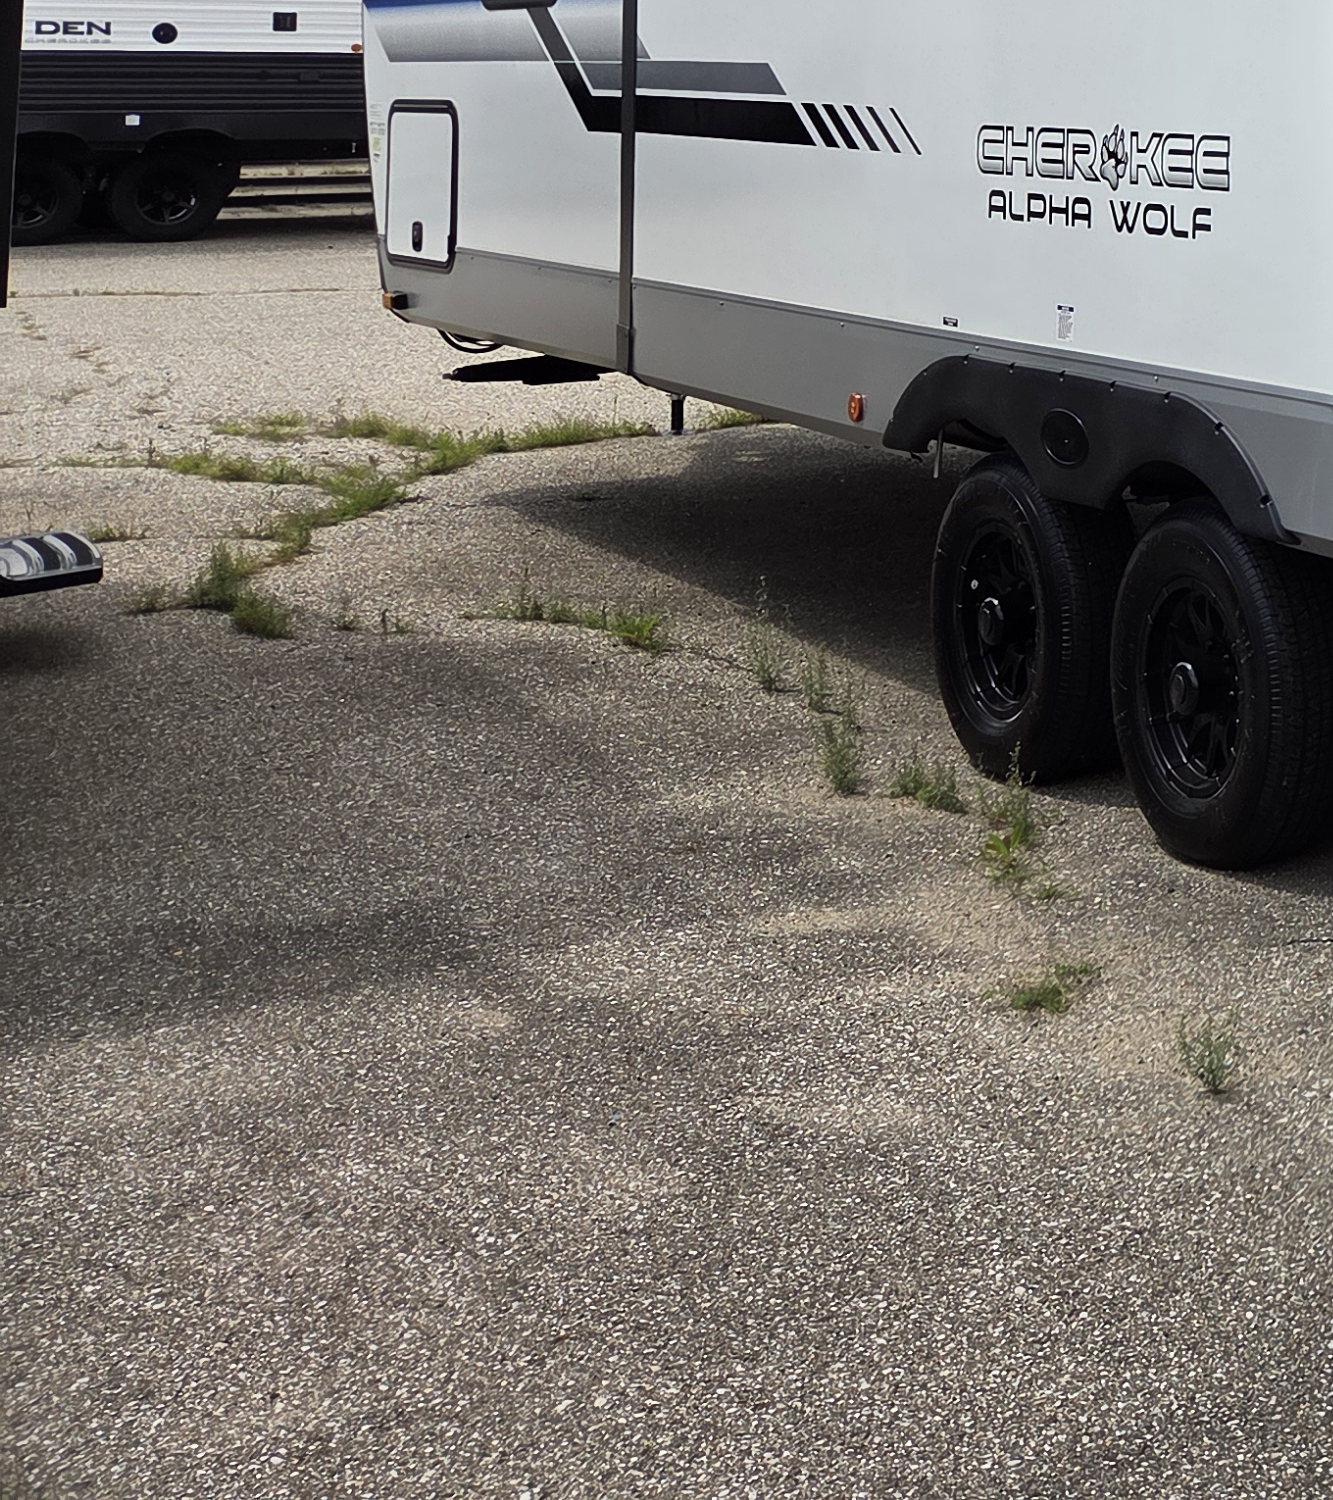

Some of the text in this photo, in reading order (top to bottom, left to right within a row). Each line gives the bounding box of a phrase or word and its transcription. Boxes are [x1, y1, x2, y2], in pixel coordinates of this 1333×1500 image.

[34, 20, 112, 36] DEN
[988, 189, 1213, 240] ALPHA WOLF
